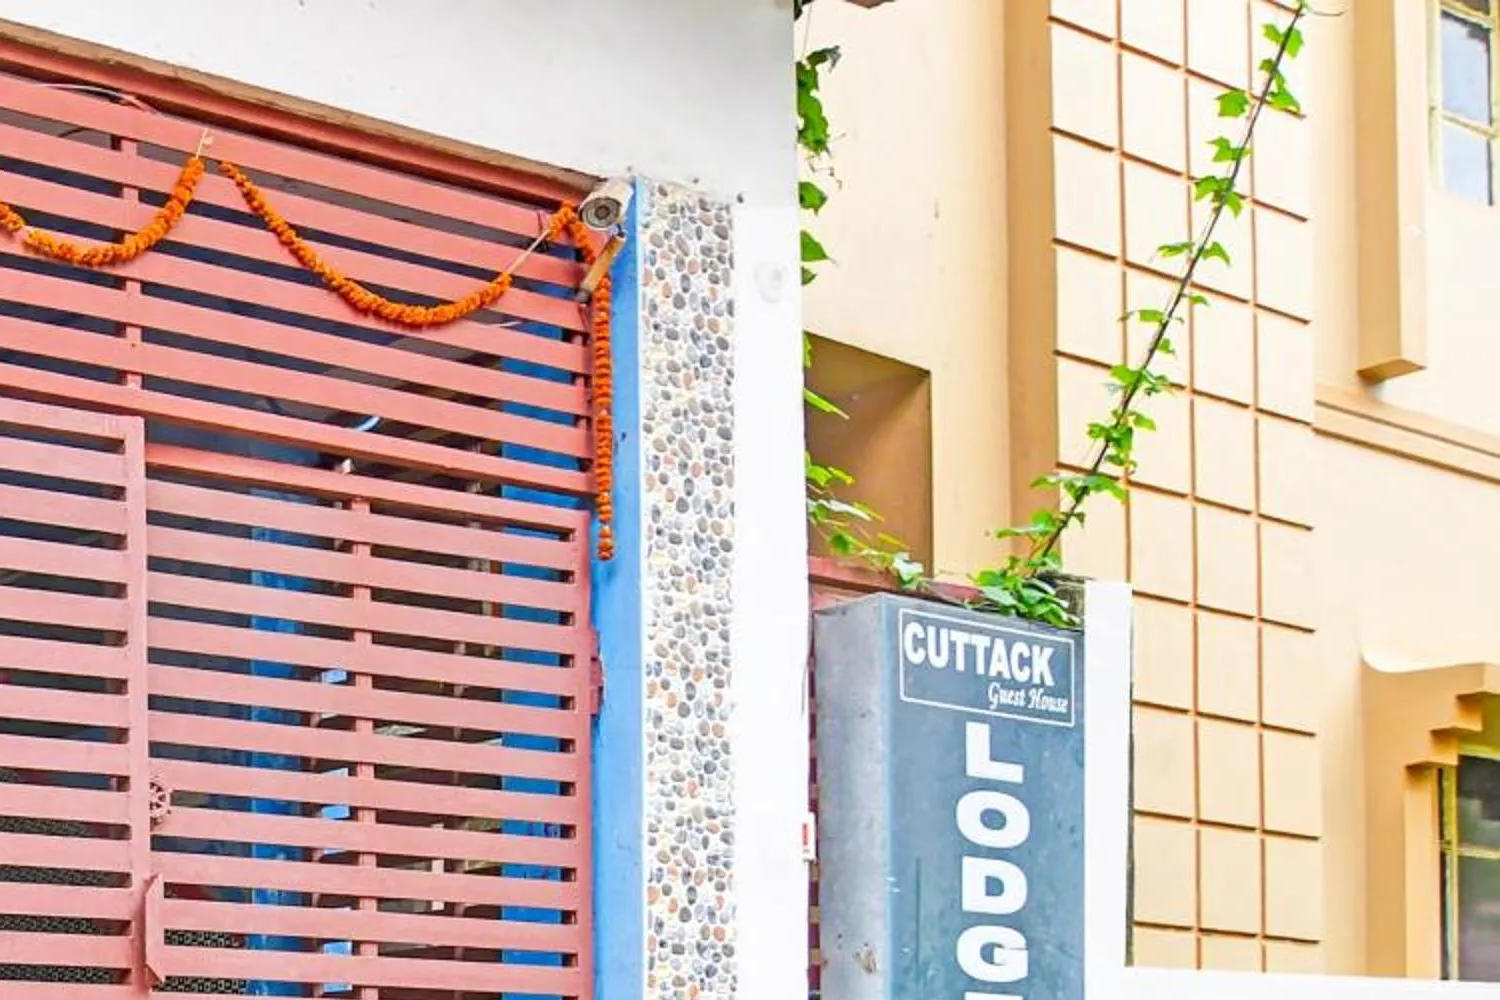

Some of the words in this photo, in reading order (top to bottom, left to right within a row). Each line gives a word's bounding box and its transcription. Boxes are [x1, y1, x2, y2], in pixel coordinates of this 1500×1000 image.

[903, 621, 1055, 686] CUTTACK
[988, 681, 1026, 710] Guest
[1028, 688, 1069, 713] House
